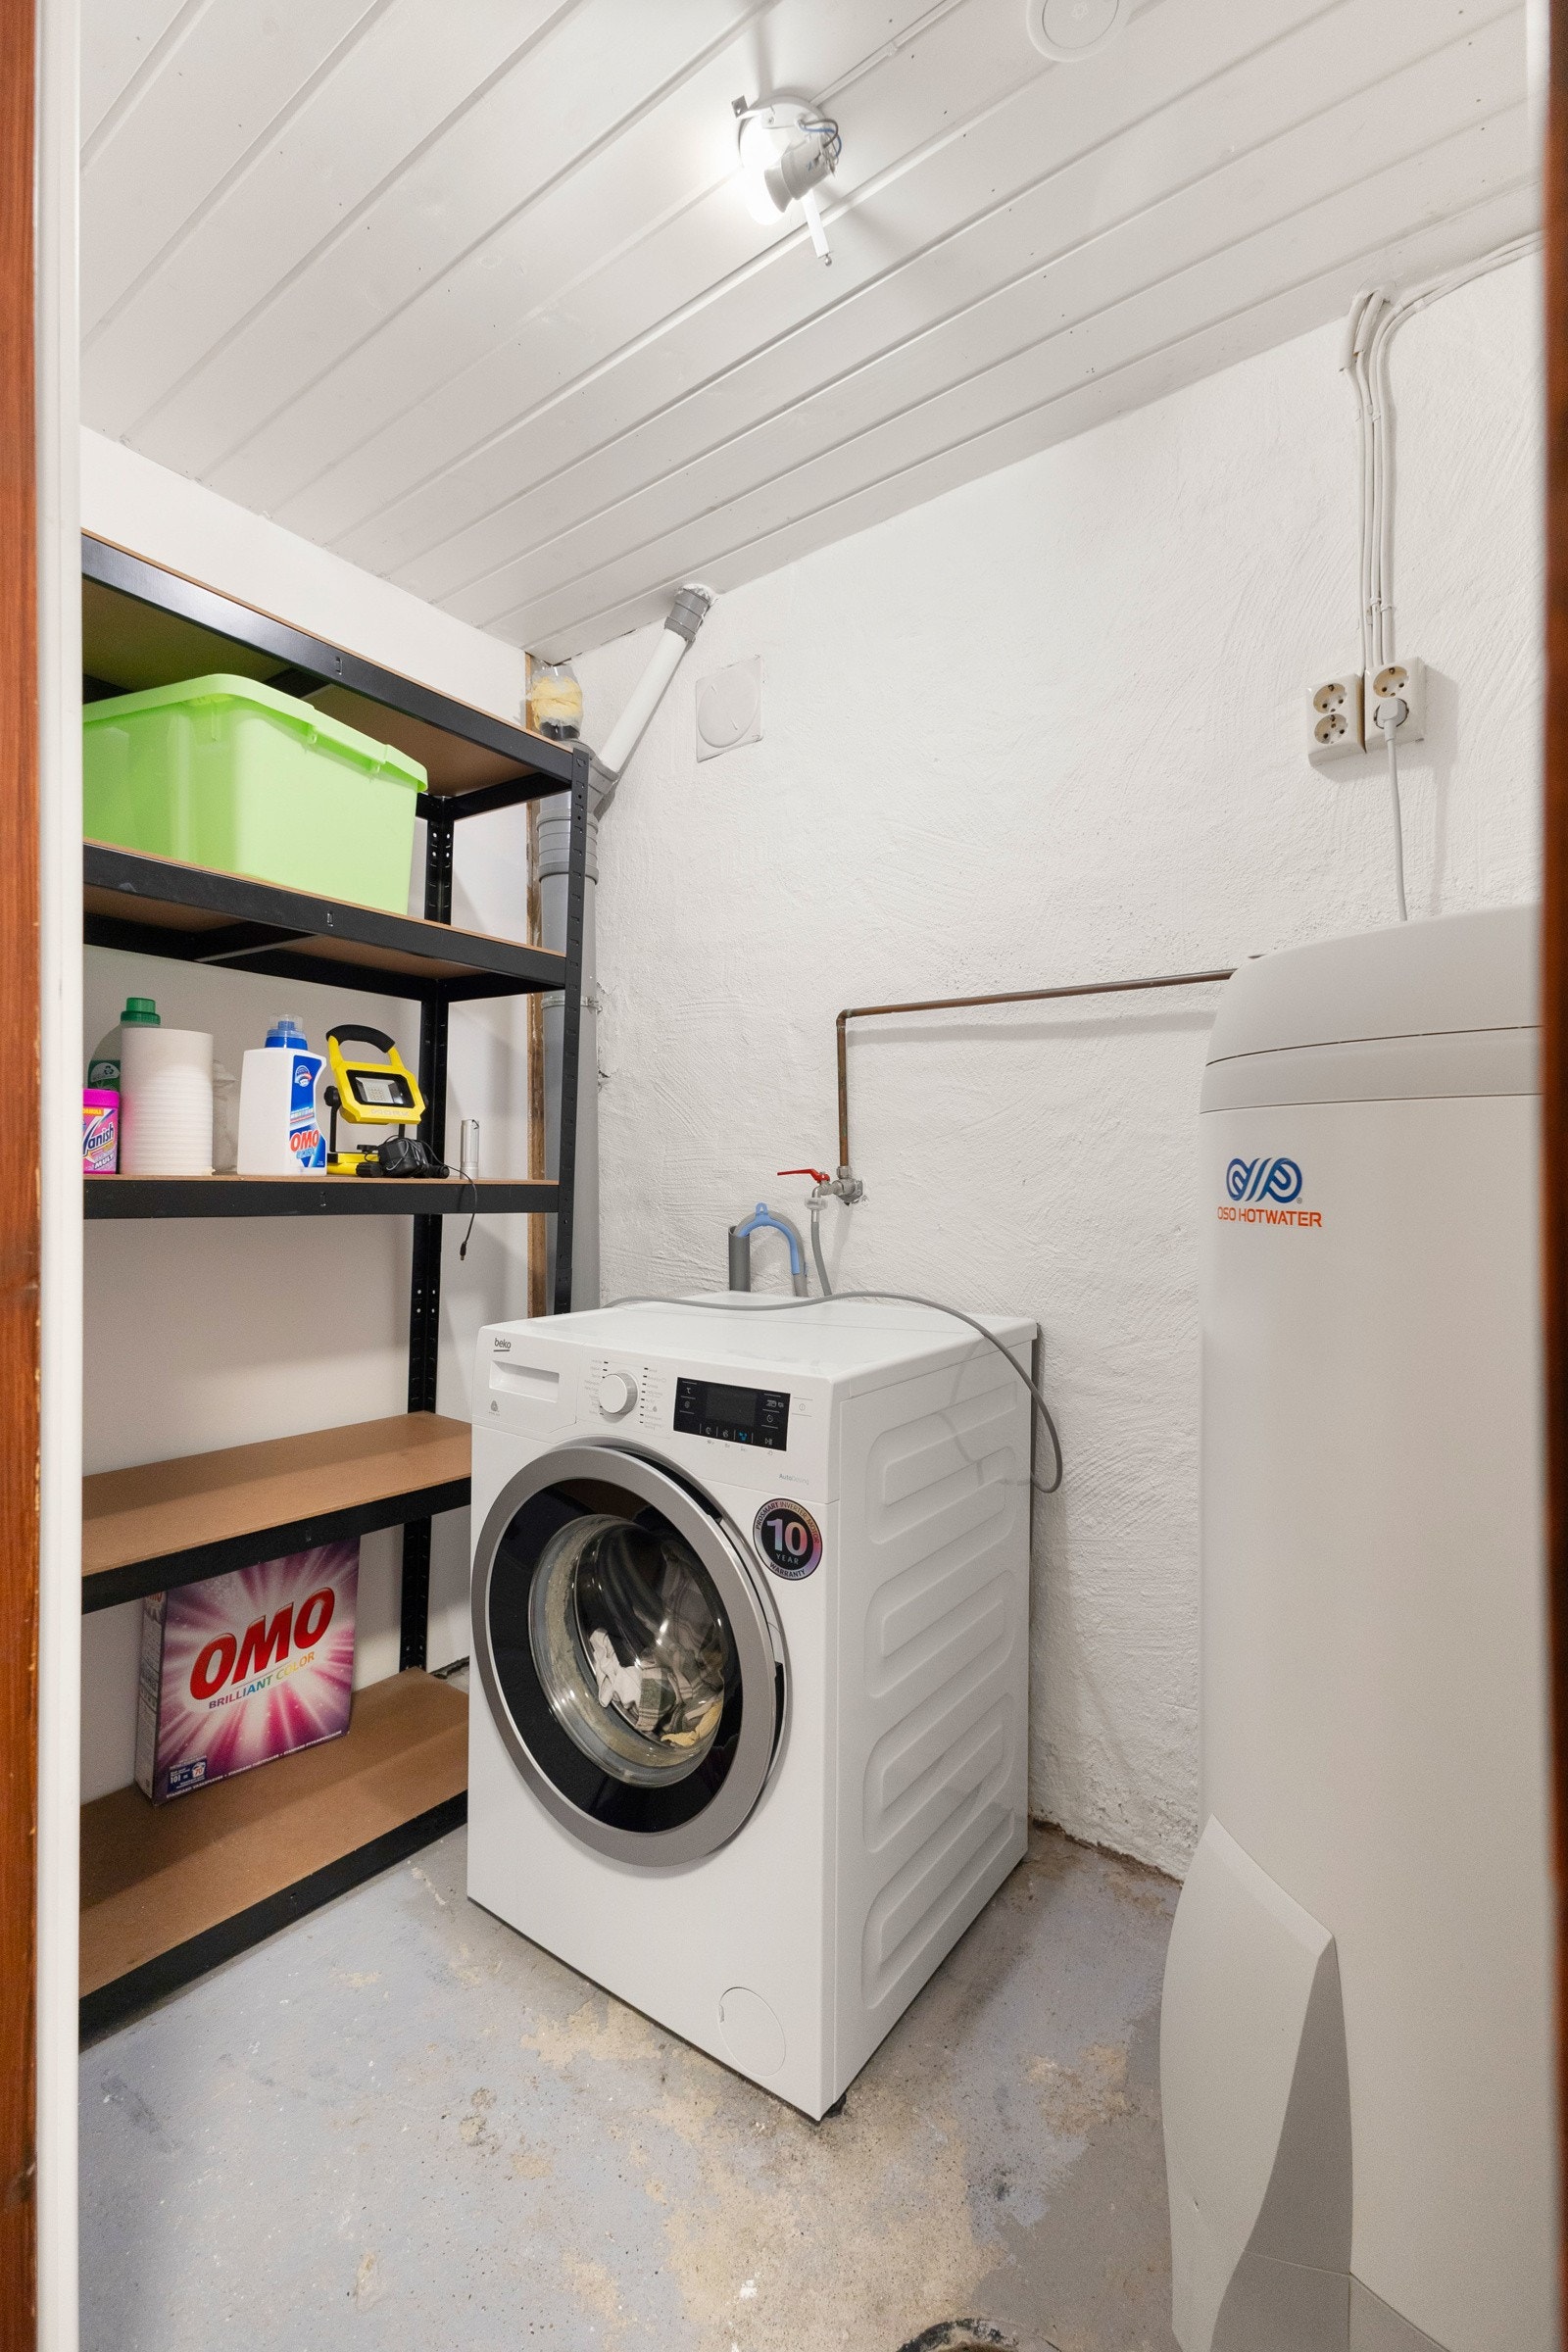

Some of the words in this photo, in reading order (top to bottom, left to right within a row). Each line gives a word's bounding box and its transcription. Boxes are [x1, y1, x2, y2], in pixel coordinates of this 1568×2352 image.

[290, 1130, 319, 1152] OMO
[1217, 1206, 1236, 1221] OSO
[1239, 1207, 1322, 1228] HOTWATER
[494, 1338, 512, 1349] beko
[756, 1501, 779, 1530] PROSMART
[779, 1501, 807, 1519] INVERTER
[807, 1519, 820, 1544] MOTOR
[766, 1518, 808, 1556] 10
[769, 1562, 806, 1578] WARRANTY
[776, 1553, 800, 1565] YEAR
[189, 1587, 336, 1701] OMO
[209, 1676, 272, 1710] BRILLIANT
[276, 1650, 316, 1681] COLOR
